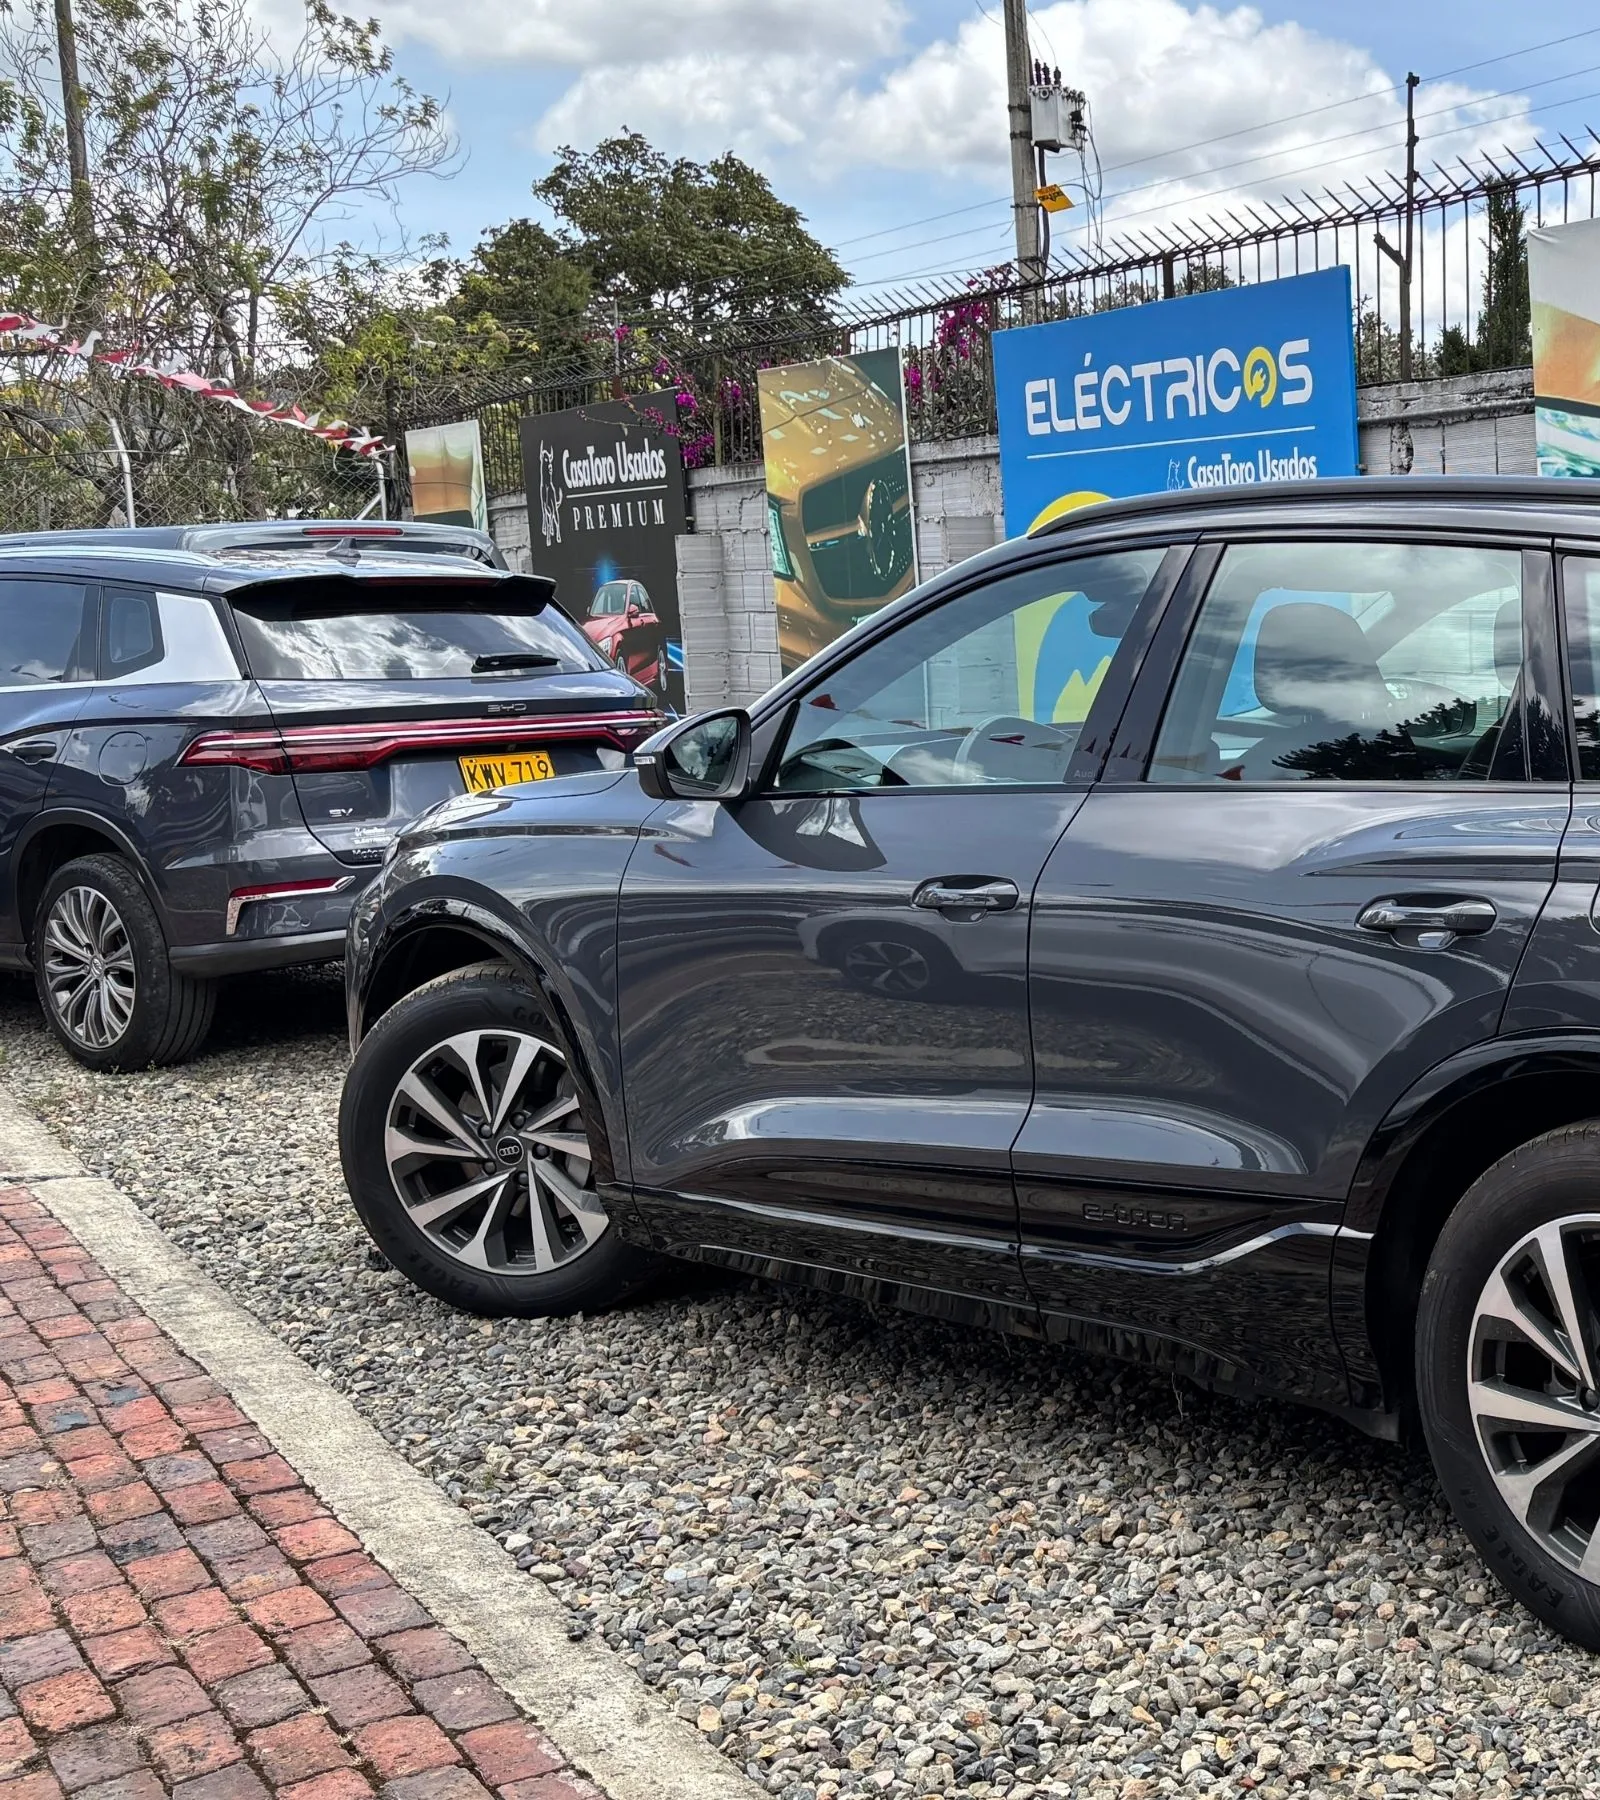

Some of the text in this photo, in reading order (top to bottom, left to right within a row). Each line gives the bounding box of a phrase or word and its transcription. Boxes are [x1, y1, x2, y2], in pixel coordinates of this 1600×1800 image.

[1025, 338, 1313, 436] ELÉCTRICOS
[563, 437, 667, 489] CasaToro Usados
[1187, 446, 1318, 488] CasaToro Usados
[572, 499, 665, 531] PREMIUM
[487, 703, 527, 713] BYD
[466, 760, 549, 789] KWV 719
